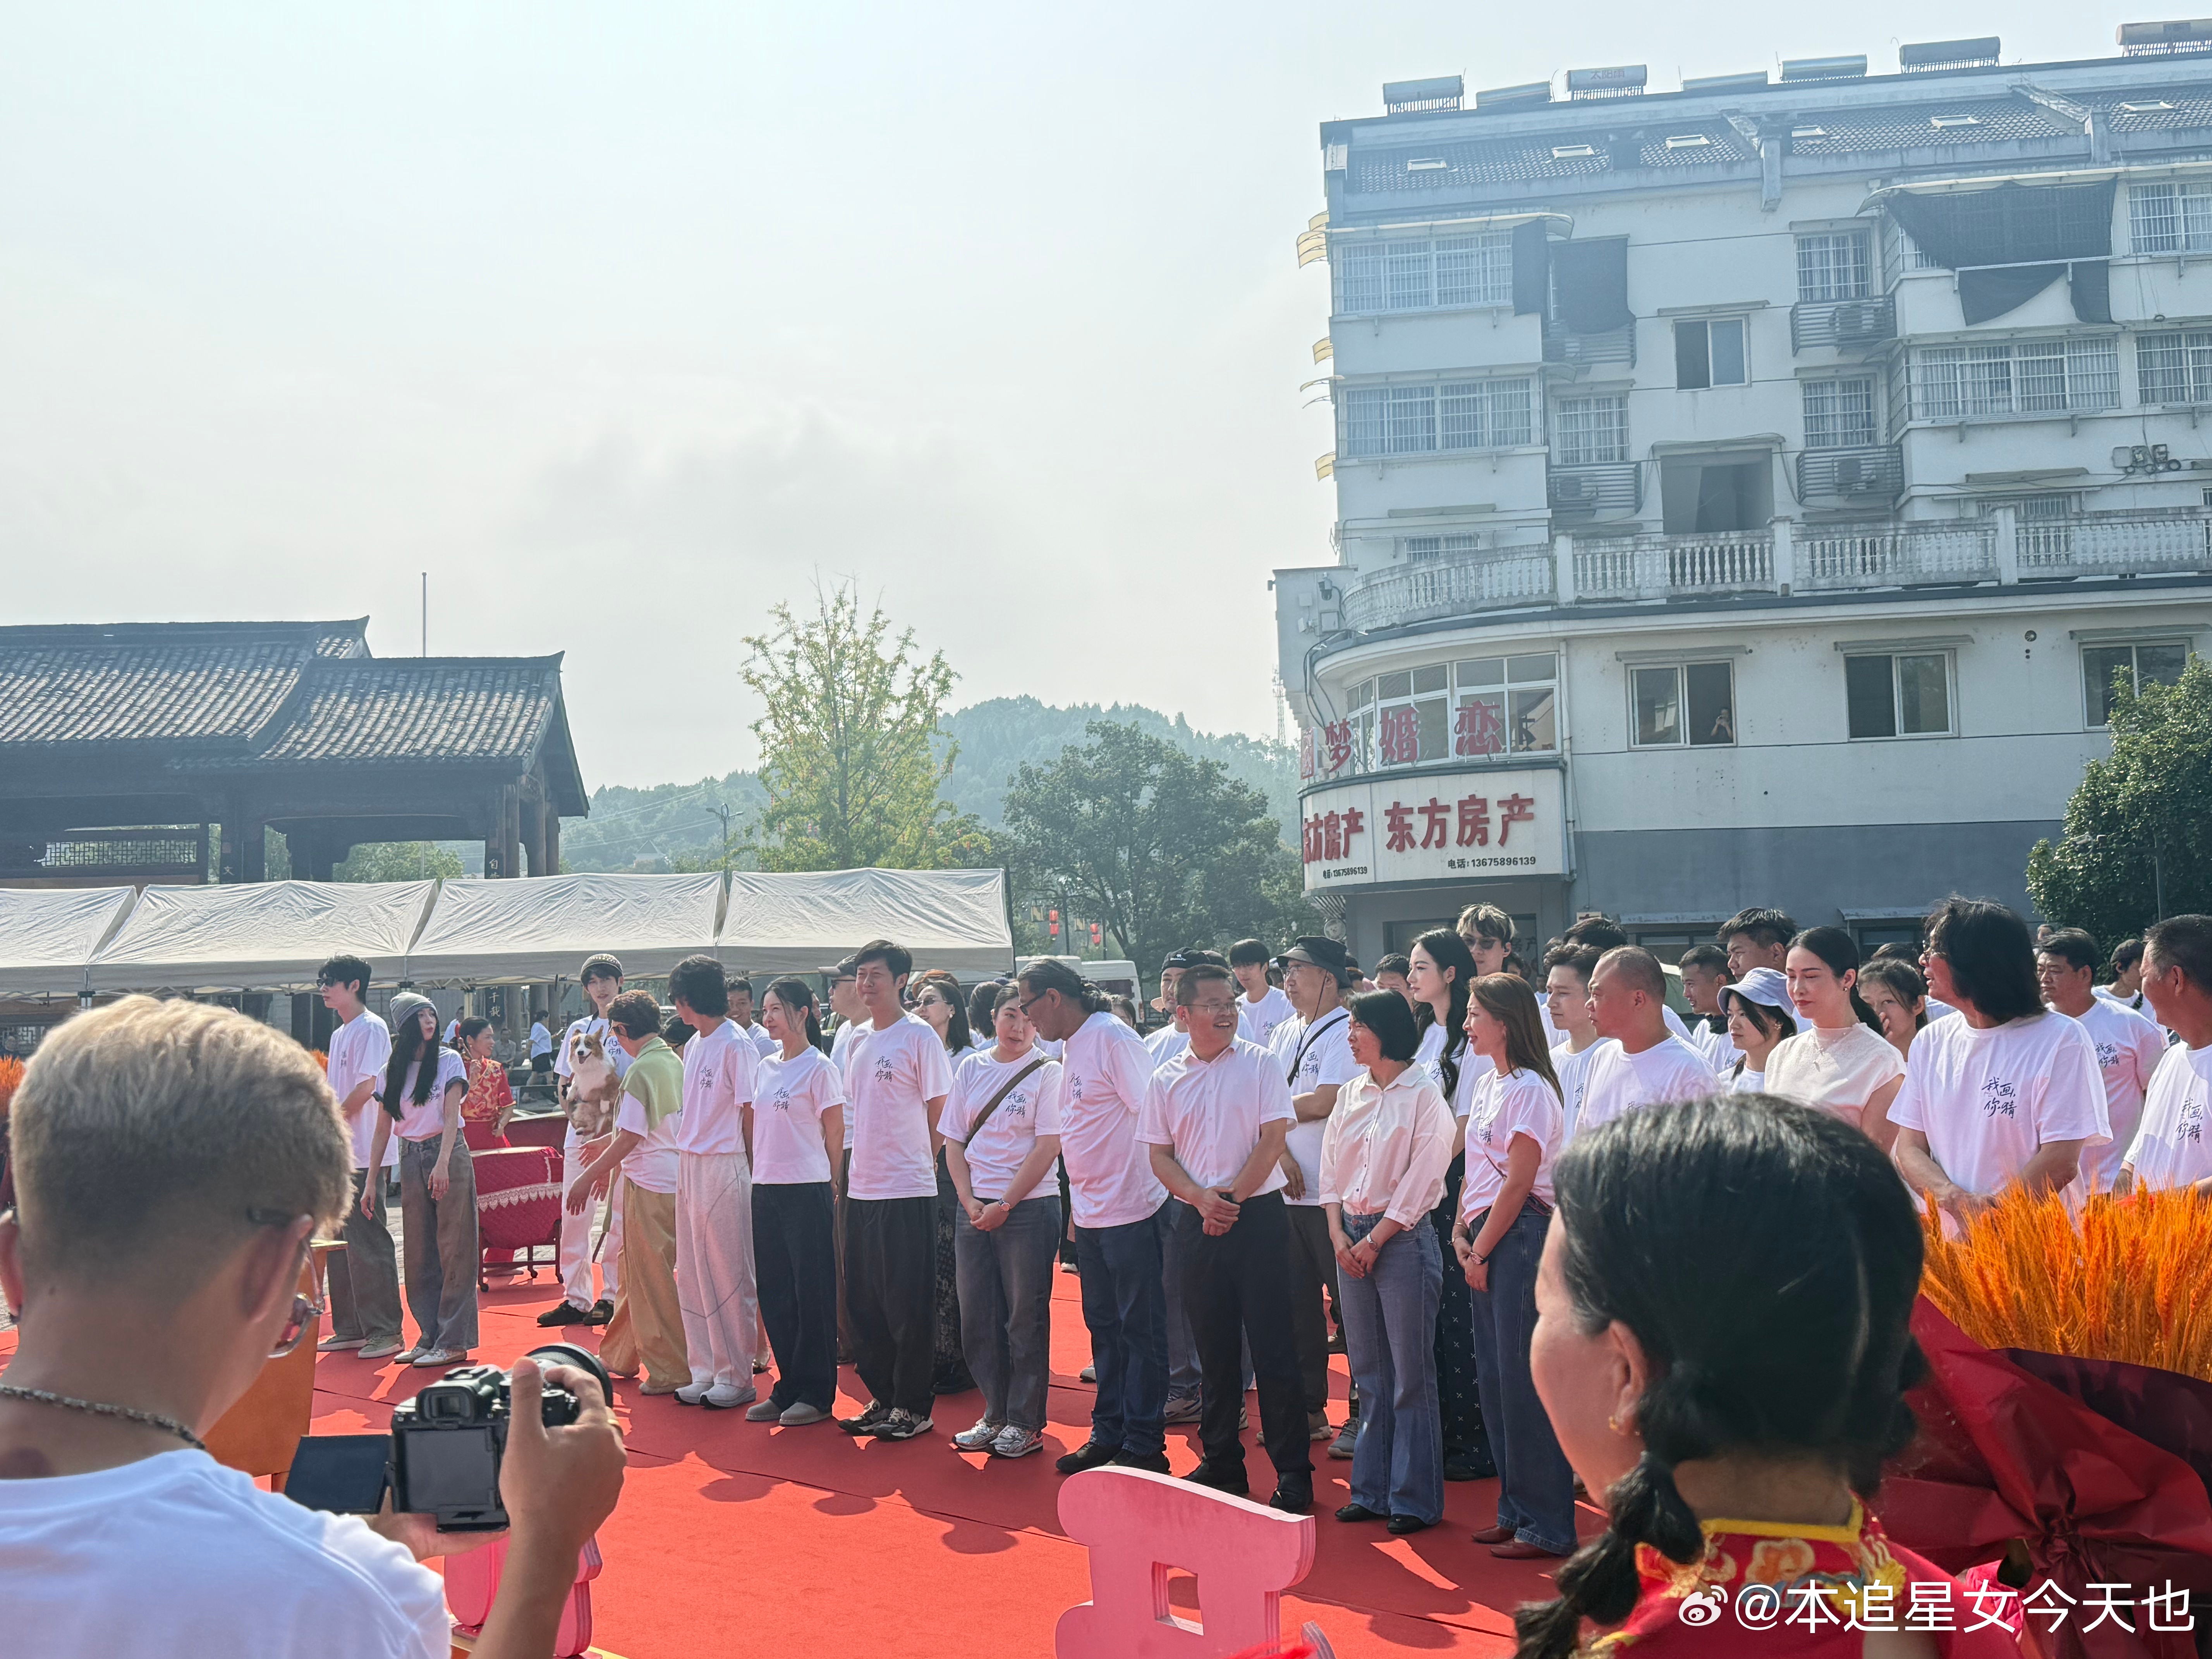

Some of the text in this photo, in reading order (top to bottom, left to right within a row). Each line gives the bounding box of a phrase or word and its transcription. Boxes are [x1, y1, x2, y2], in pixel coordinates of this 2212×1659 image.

[1590, 69, 1625, 80] 太阳雨
[1300, 699, 1502, 780] 梦婚恋
[1384, 793, 1534, 853] 东方房产
[1006, 1104, 1026, 1118] 你猜
[1984, 1097, 2017, 1119] 你猜
[2175, 1120, 2202, 1144] 你猜
